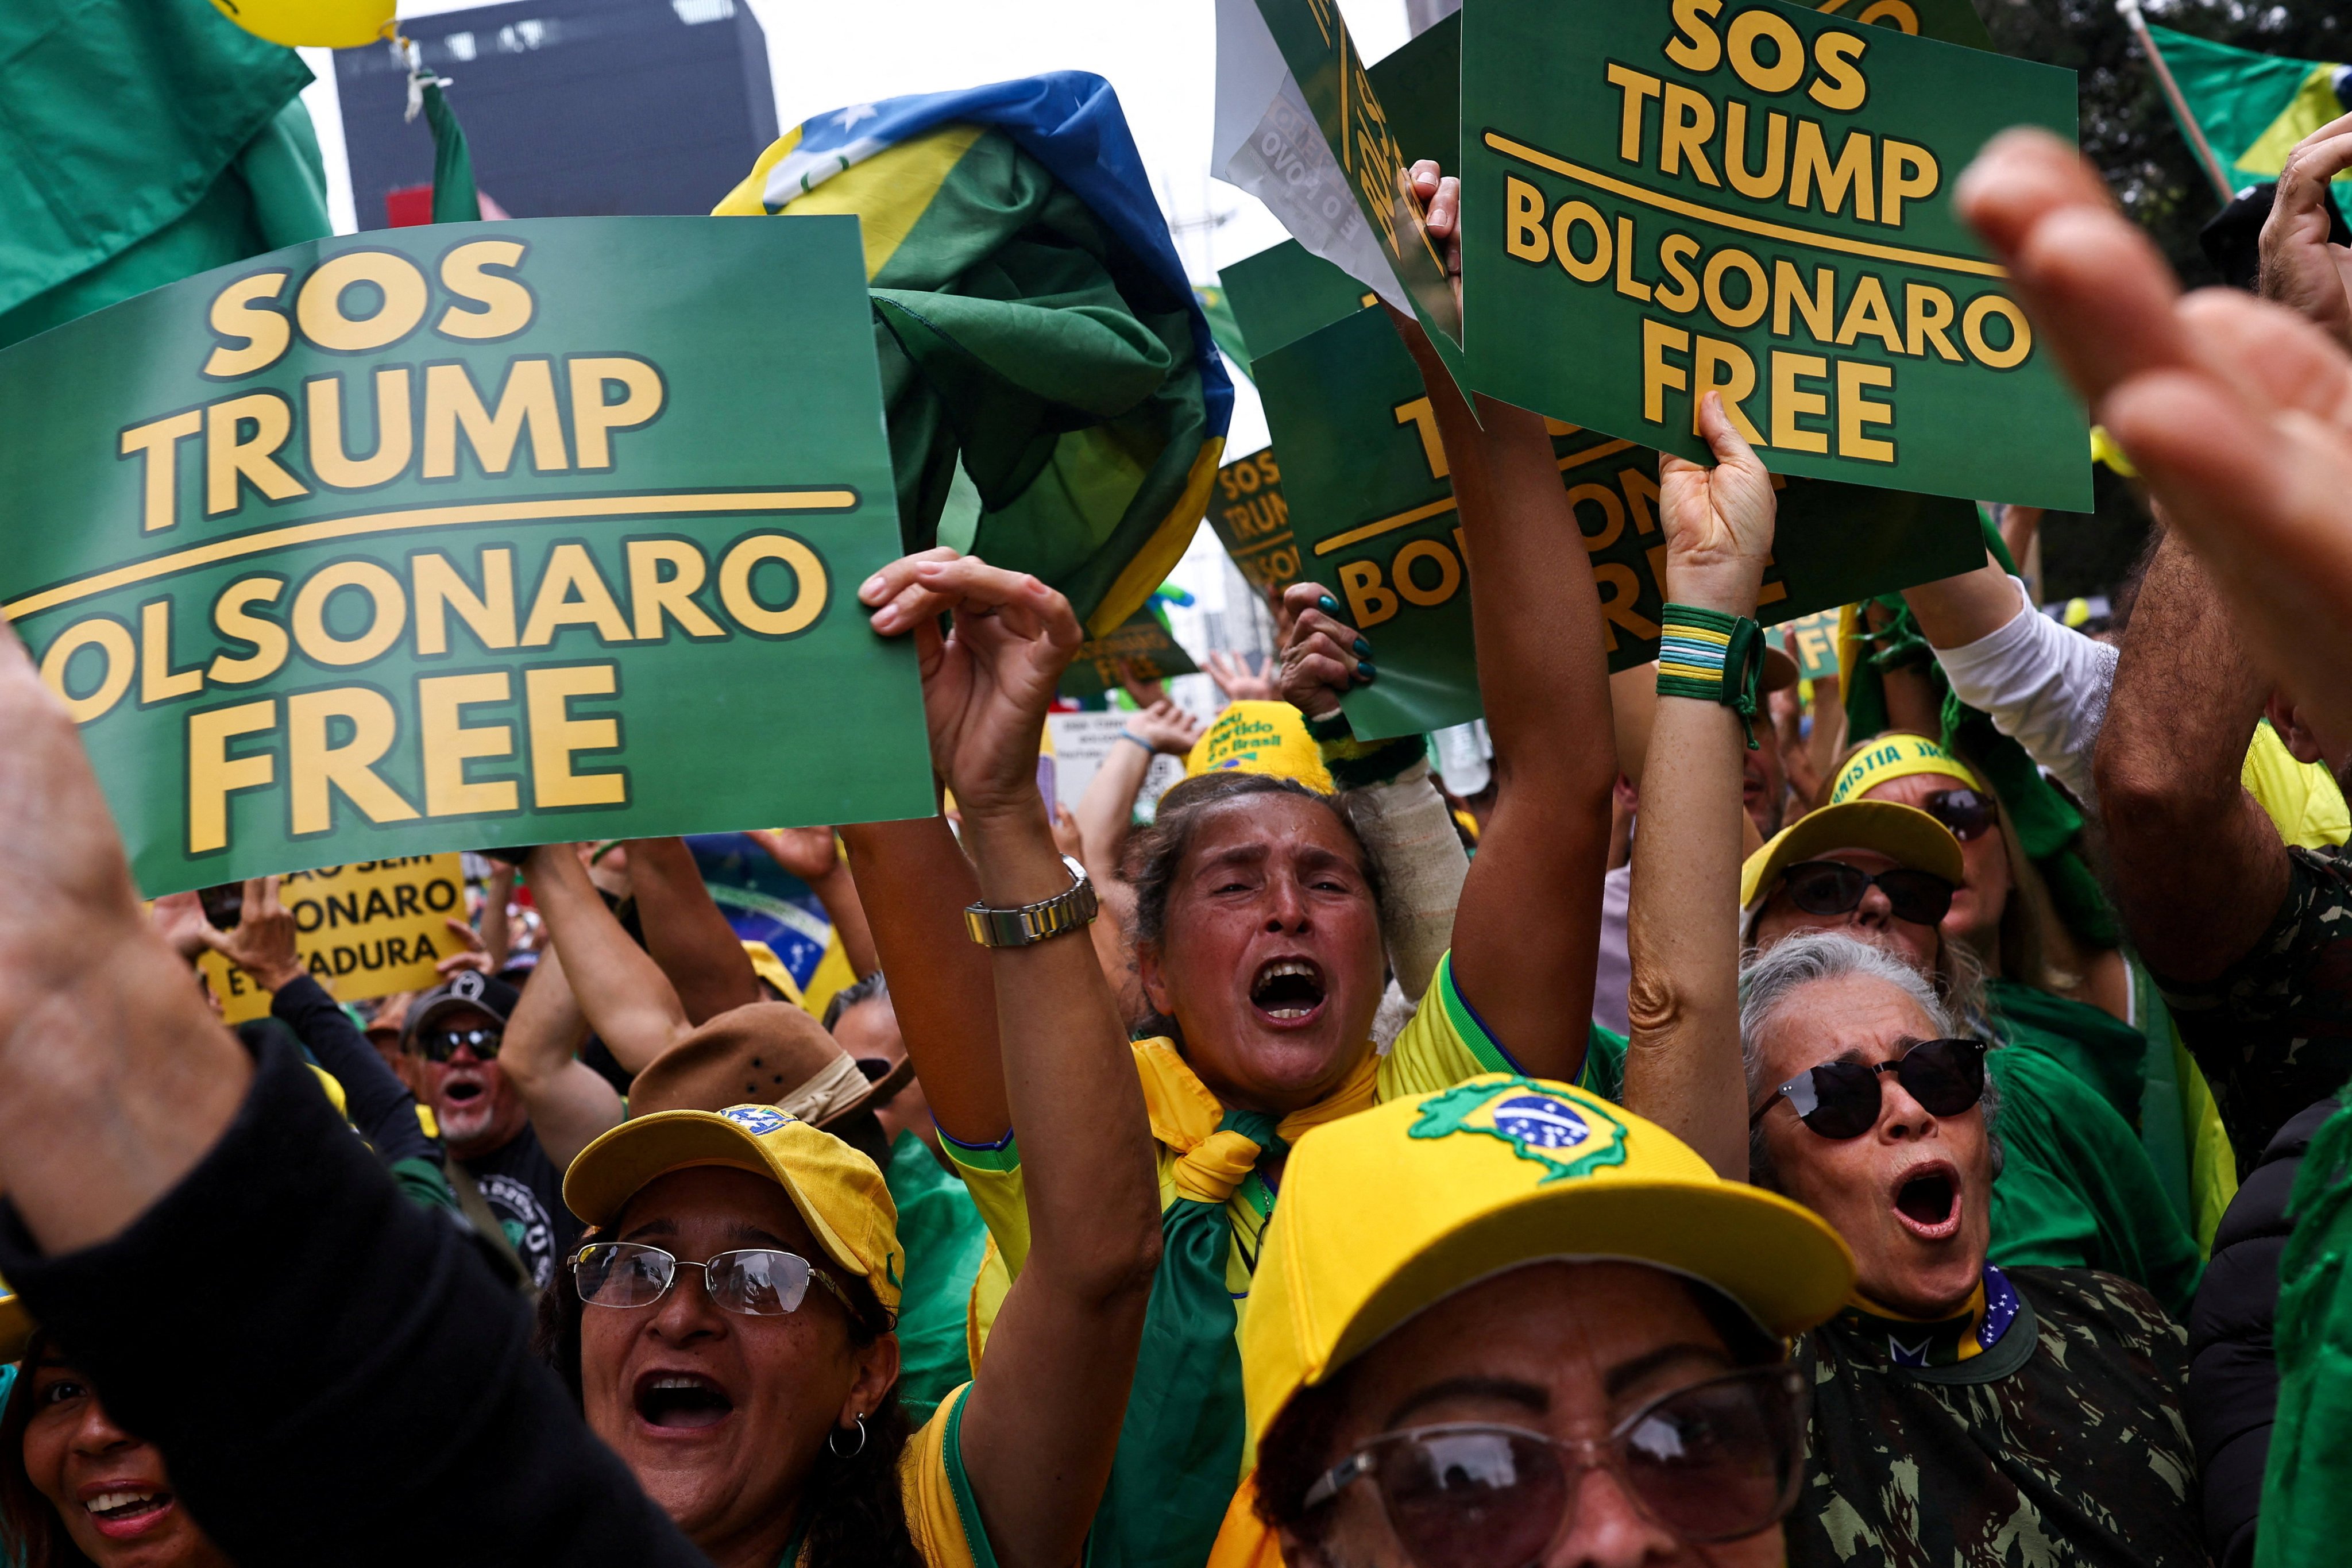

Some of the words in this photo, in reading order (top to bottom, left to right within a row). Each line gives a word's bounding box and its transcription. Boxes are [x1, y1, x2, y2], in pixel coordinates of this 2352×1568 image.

[1664, 0, 1868, 111] SOS
[1607, 62, 1940, 226] TRUMP
[201, 238, 534, 379] SOS
[1506, 175, 2033, 370] BOLSONARO
[121, 356, 665, 533] TRUMP
[1642, 317, 1895, 464] FREE
[1218, 450, 1281, 501] SOS
[39, 534, 829, 725] OLSONARO
[187, 665, 627, 855] FREE
[1208, 720, 1273, 753] partido
[1233, 735, 1281, 751] Brasil
[293, 878, 457, 932] ONARO
